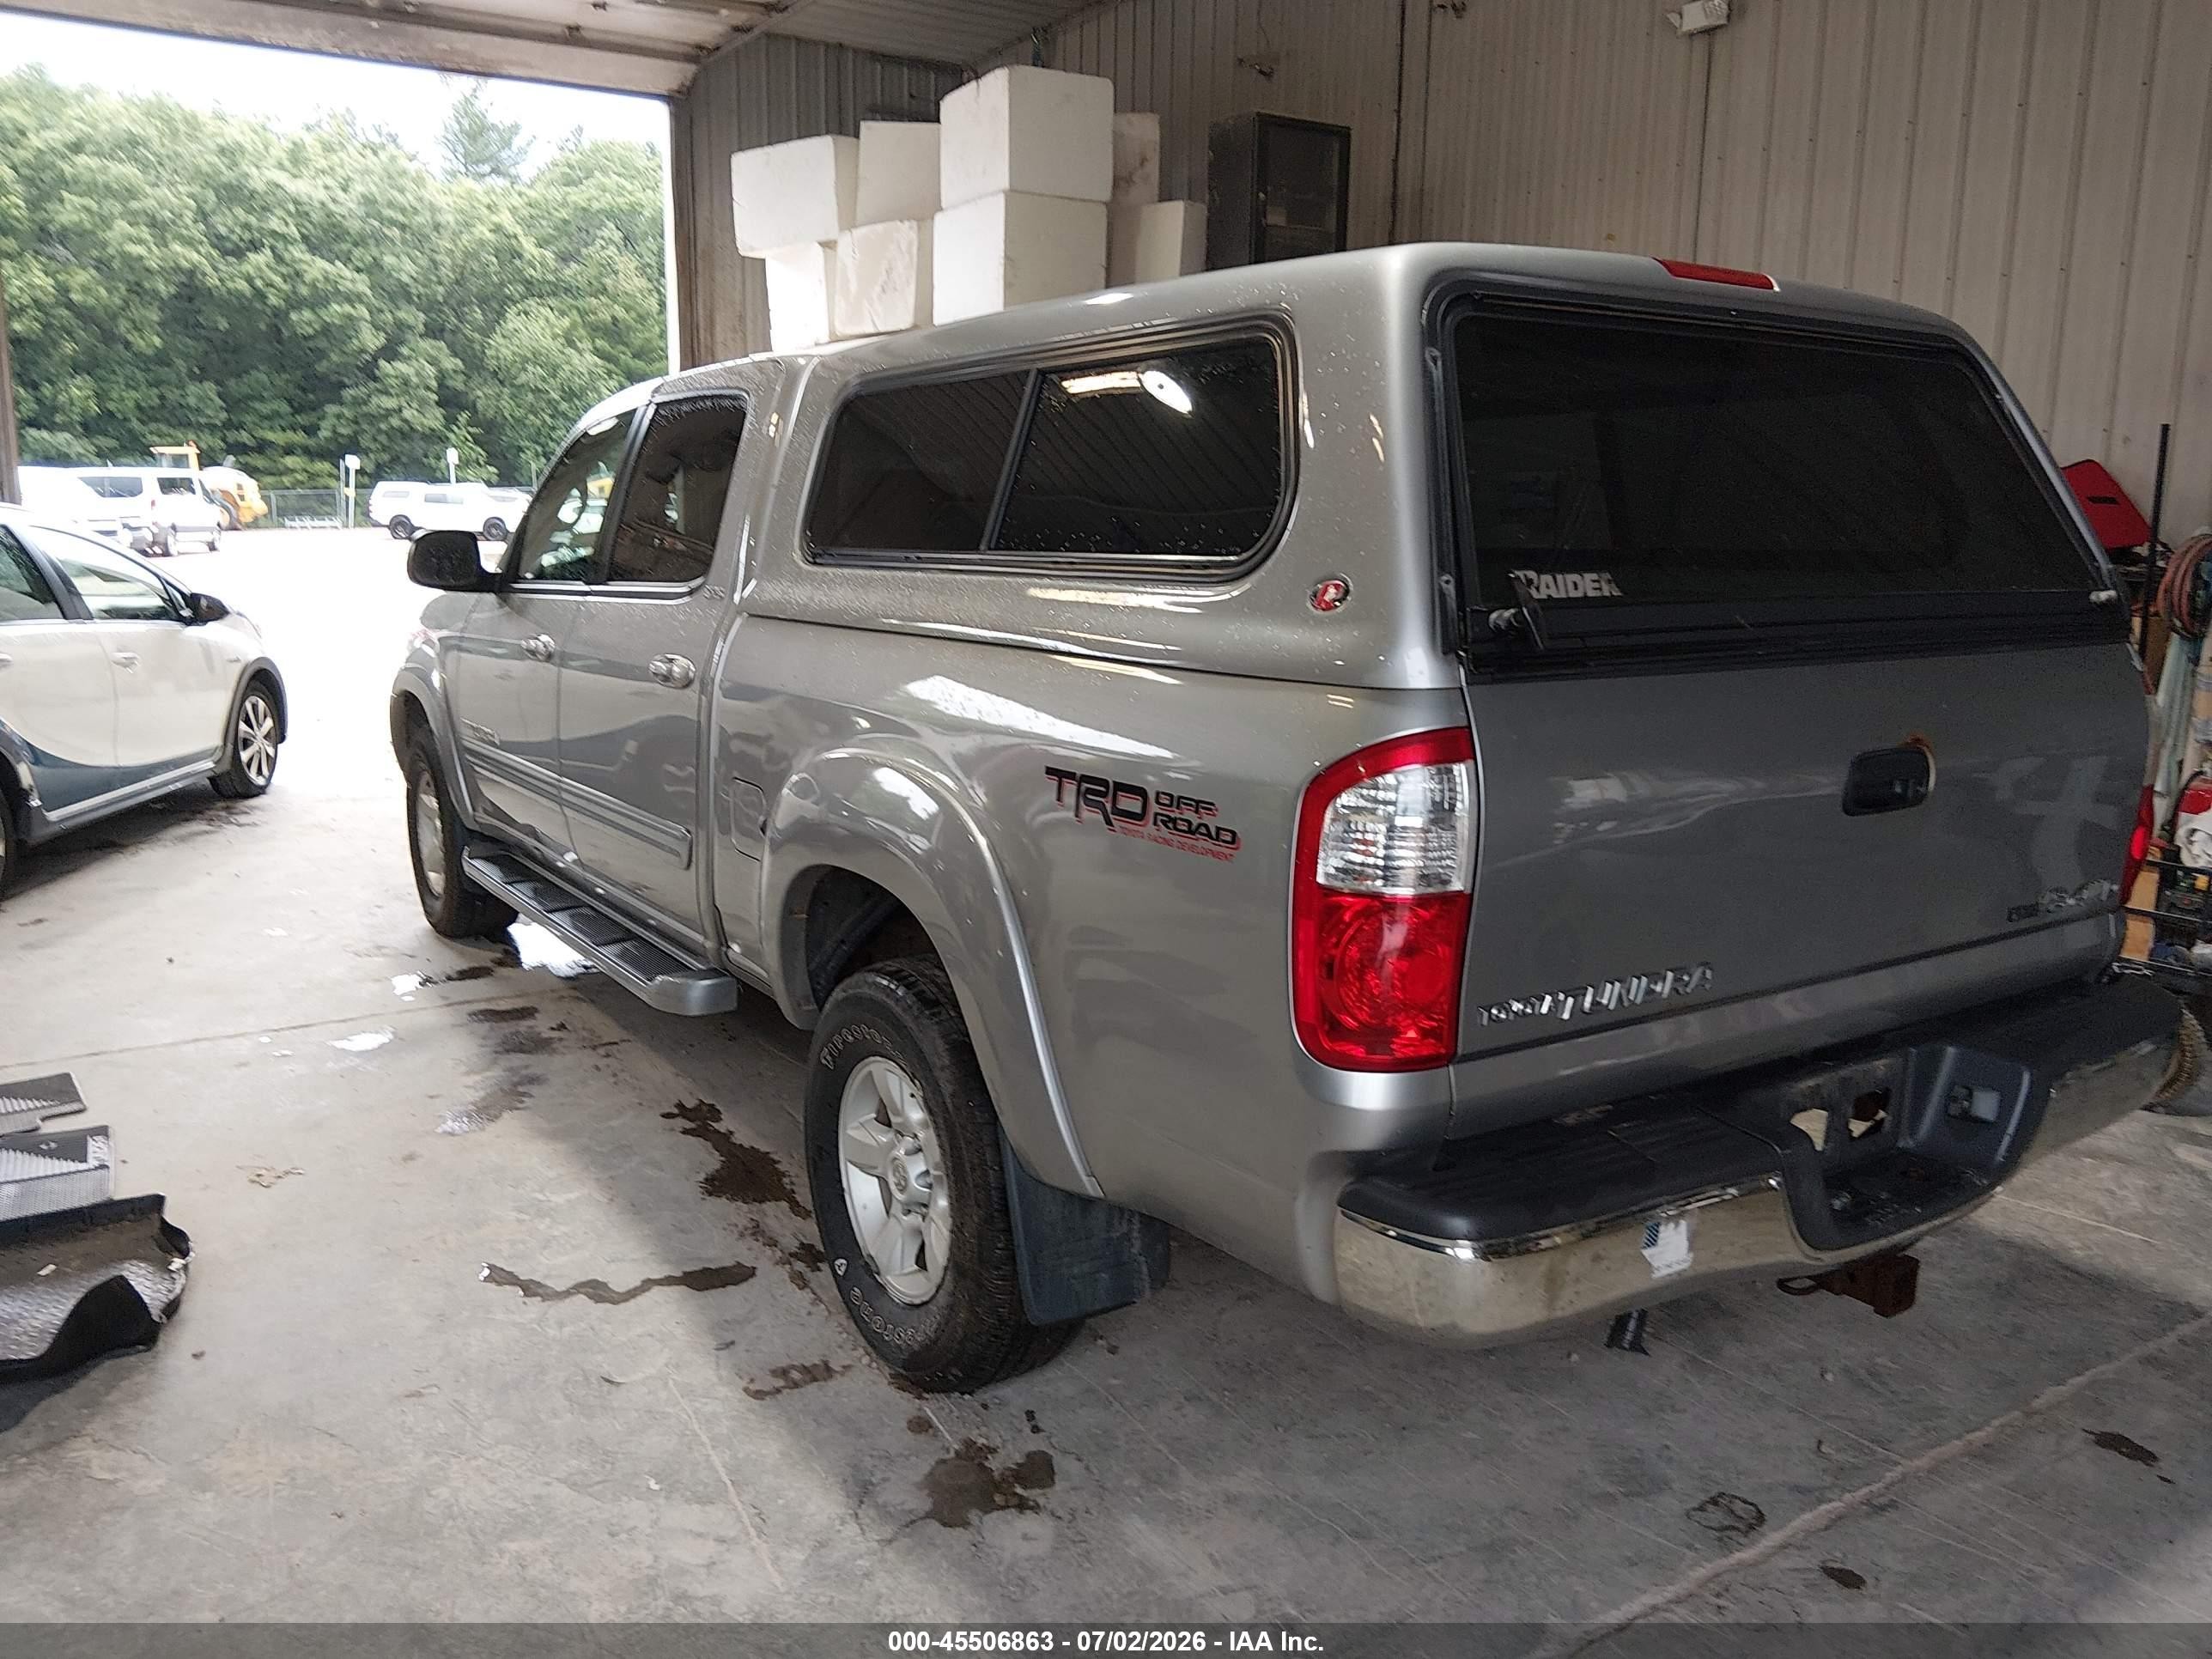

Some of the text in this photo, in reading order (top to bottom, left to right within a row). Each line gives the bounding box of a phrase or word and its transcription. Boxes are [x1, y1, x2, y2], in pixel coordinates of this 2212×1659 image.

[1510, 568, 1624, 599] RAIDER
[1044, 765, 1219, 833] TRD OFF
[1152, 811, 1242, 852] ROAD
